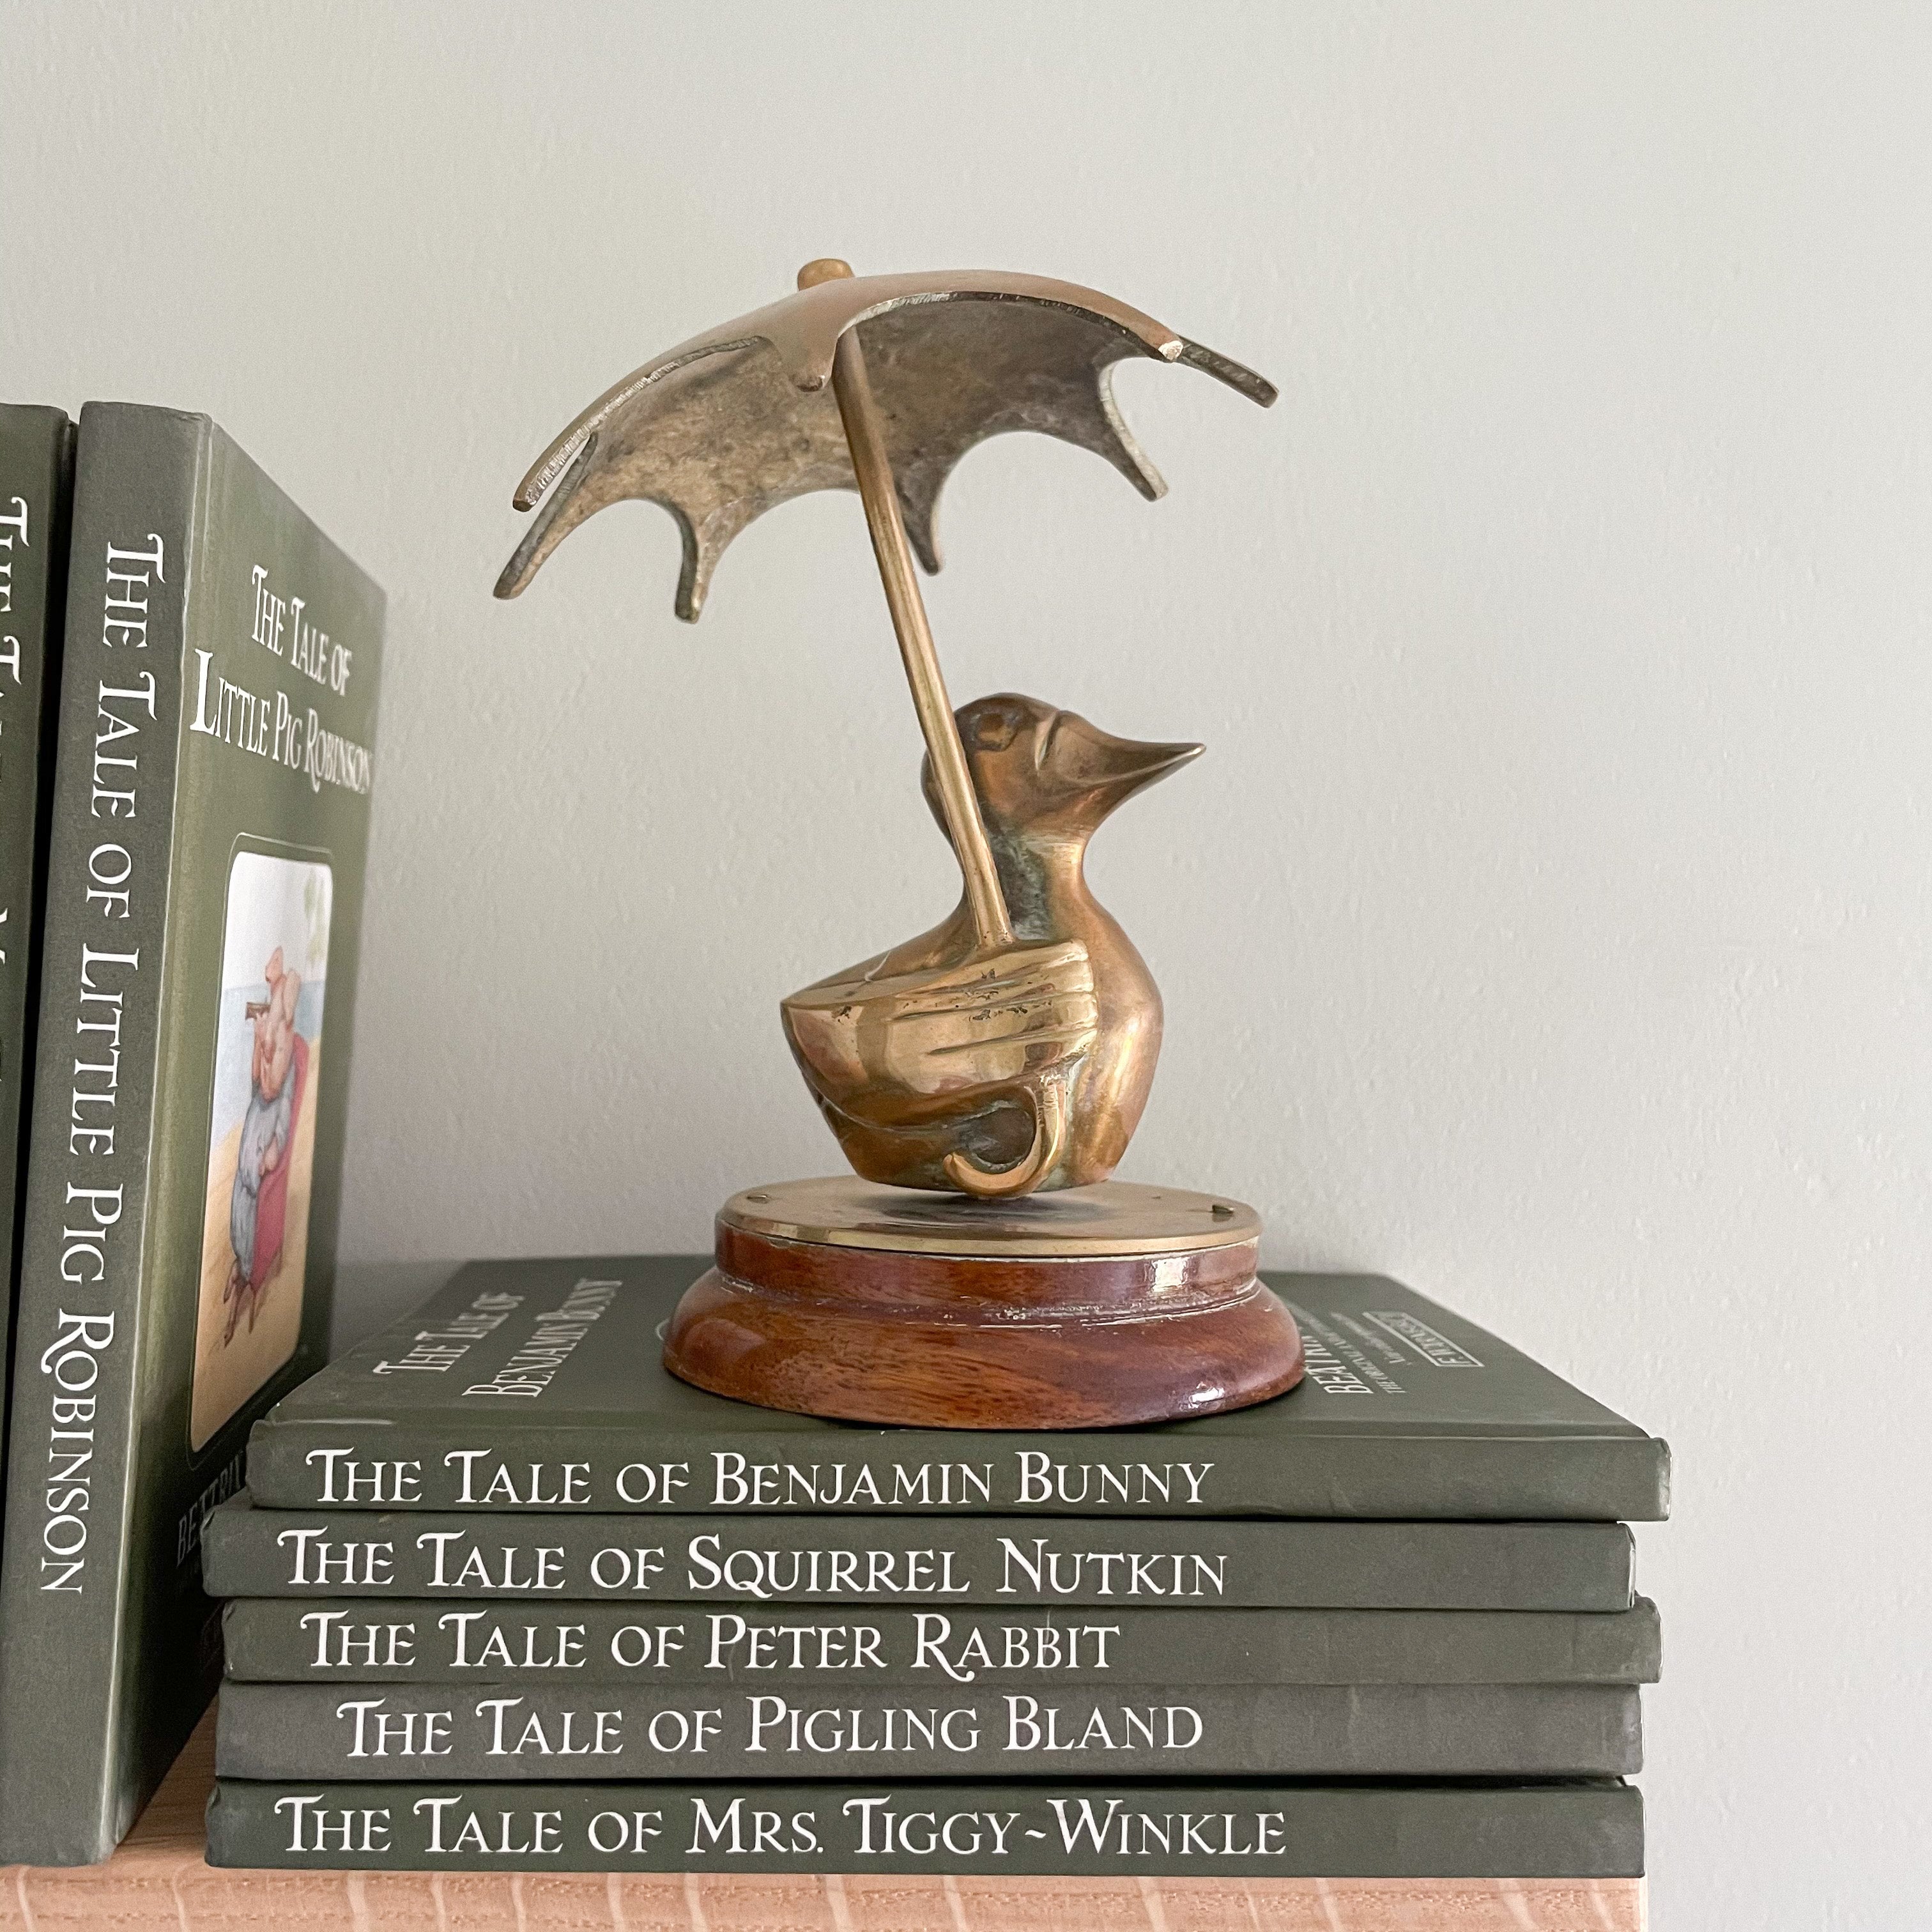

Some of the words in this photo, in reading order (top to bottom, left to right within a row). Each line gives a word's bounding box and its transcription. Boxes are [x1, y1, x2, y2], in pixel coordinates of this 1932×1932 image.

[102, 533, 166, 648] THE
[252, 565, 286, 657] THE
[291, 597, 330, 686] TALE
[330, 644, 352, 696] OF
[91, 671, 158, 818] TALE
[190, 648, 270, 757] LITTLE
[272, 690, 303, 770] PIG
[304, 707, 371, 794] ROBINSON
[86, 843, 132, 919] OF
[69, 942, 140, 1156] LITTLE
[60, 1181, 123, 1285] PIG
[372, 1344, 471, 1375] THE
[415, 1312, 509, 1341] TALE
[461, 1322, 588, 1398] BENJAMIN
[40, 1308, 116, 1595] ROBINSON
[305, 1446, 422, 1502] THE
[444, 1448, 592, 1504] TALE
[616, 1462, 689, 1504] OF
[710, 1452, 994, 1505] BENJAMIN
[1014, 1452, 1215, 1503] BUNNY
[277, 1526, 394, 1584] THE
[416, 1529, 566, 1590] TALE
[590, 1547, 665, 1590] OF
[687, 1533, 970, 1598] SQUIRREL
[995, 1538, 1227, 1595] NUTKIN
[300, 1610, 416, 1667] THE
[438, 1609, 586, 1667] TALE
[611, 1625, 685, 1667] OF
[703, 1614, 888, 1669] PETER
[910, 1613, 1121, 1682] RABBIT
[336, 1698, 453, 1757] THE
[475, 1696, 624, 1755] TALE
[648, 1708, 722, 1752] OF
[744, 1696, 981, 1752] PIGLING
[1002, 1695, 1203, 1751] BLAND
[274, 1793, 392, 1851] THE
[413, 1795, 564, 1853] TALE
[585, 1798, 663, 1853] OF
[685, 1798, 824, 1853] MRS.
